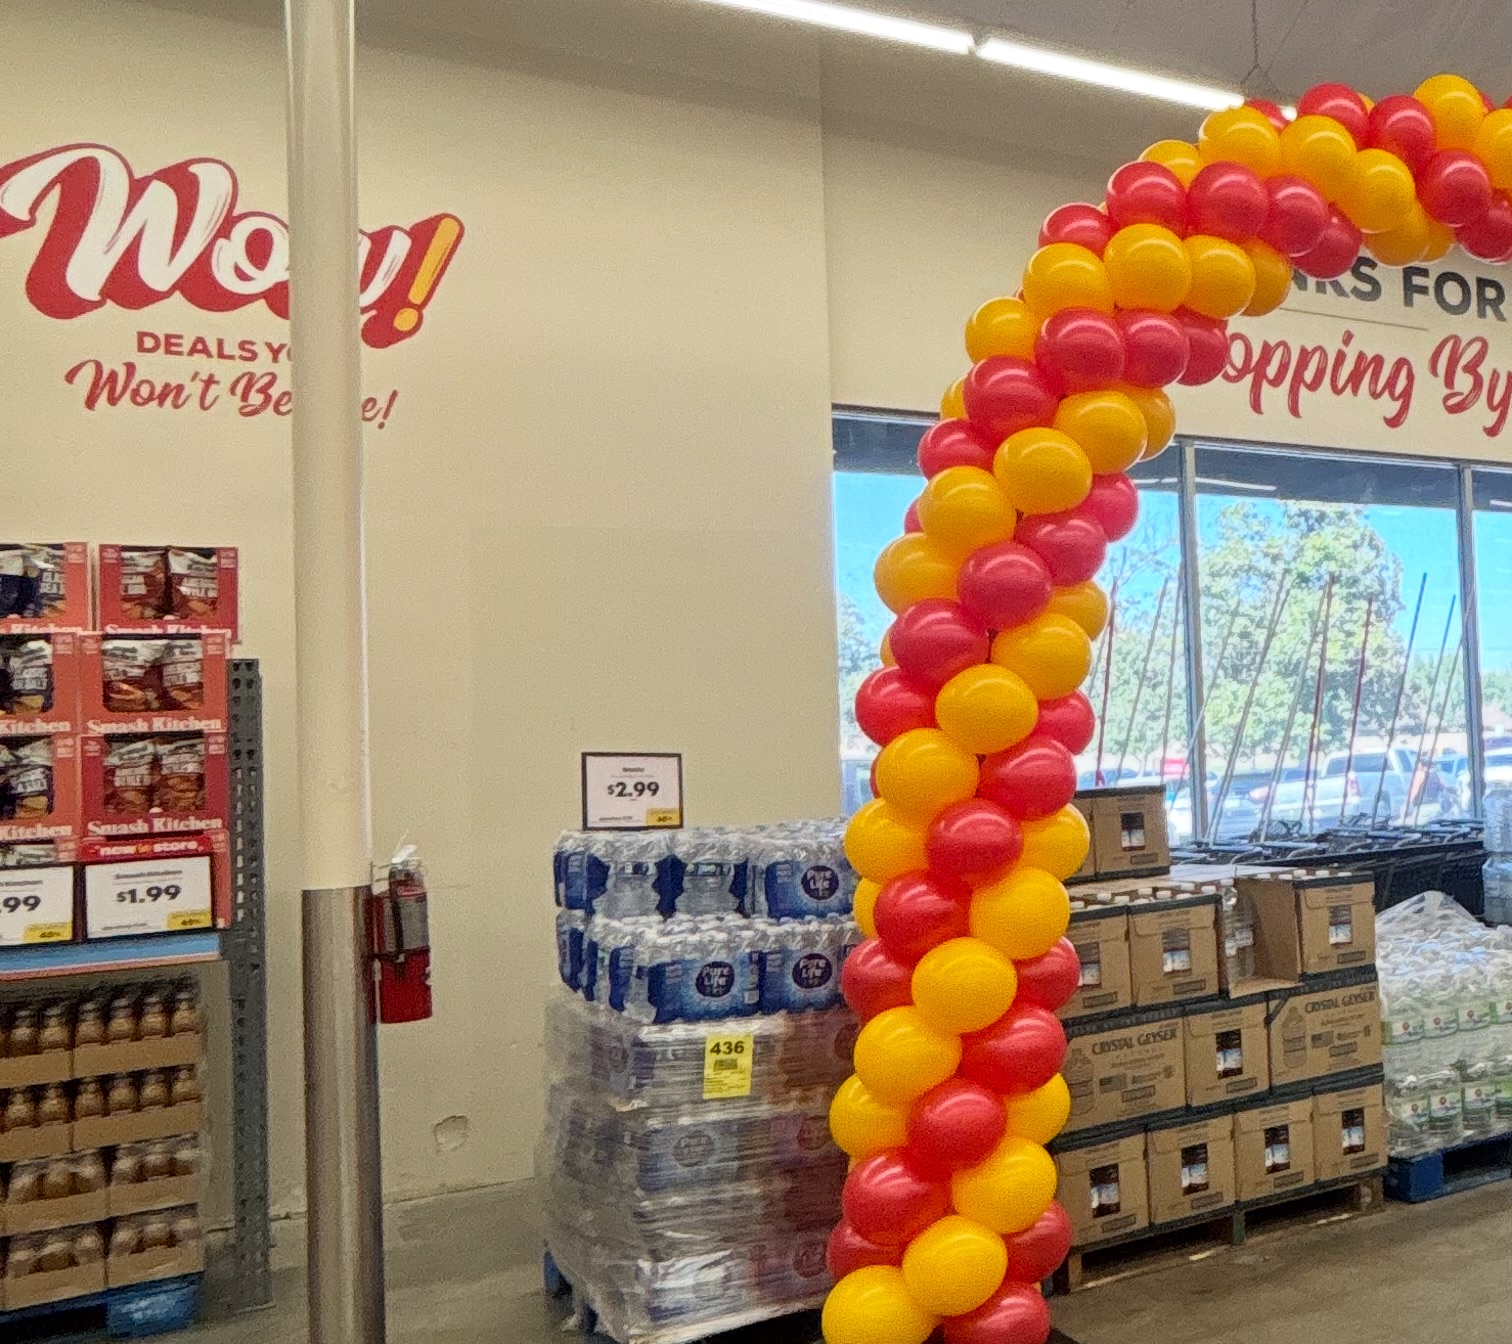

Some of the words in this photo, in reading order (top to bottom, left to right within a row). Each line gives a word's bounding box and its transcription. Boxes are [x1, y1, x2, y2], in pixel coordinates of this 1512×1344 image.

[1403, 265, 1507, 322] FOR
[136, 330, 257, 362] DEALS
[64, 358, 220, 412] Won't
[1223, 330, 1415, 429] opping
[87, 718, 149, 734] Smash
[151, 715, 222, 732] Kitchen
[607, 781, 660, 798] $2.99
[87, 819, 149, 836] Smash
[152, 816, 223, 832] Kitchen
[153, 841, 198, 853] store
[116, 884, 182, 904] $1.99
[709, 1040, 746, 1056] 436
[1091, 1037, 1135, 1055] CRYSTAL
[1137, 1027, 1178, 1046] GEYSER
